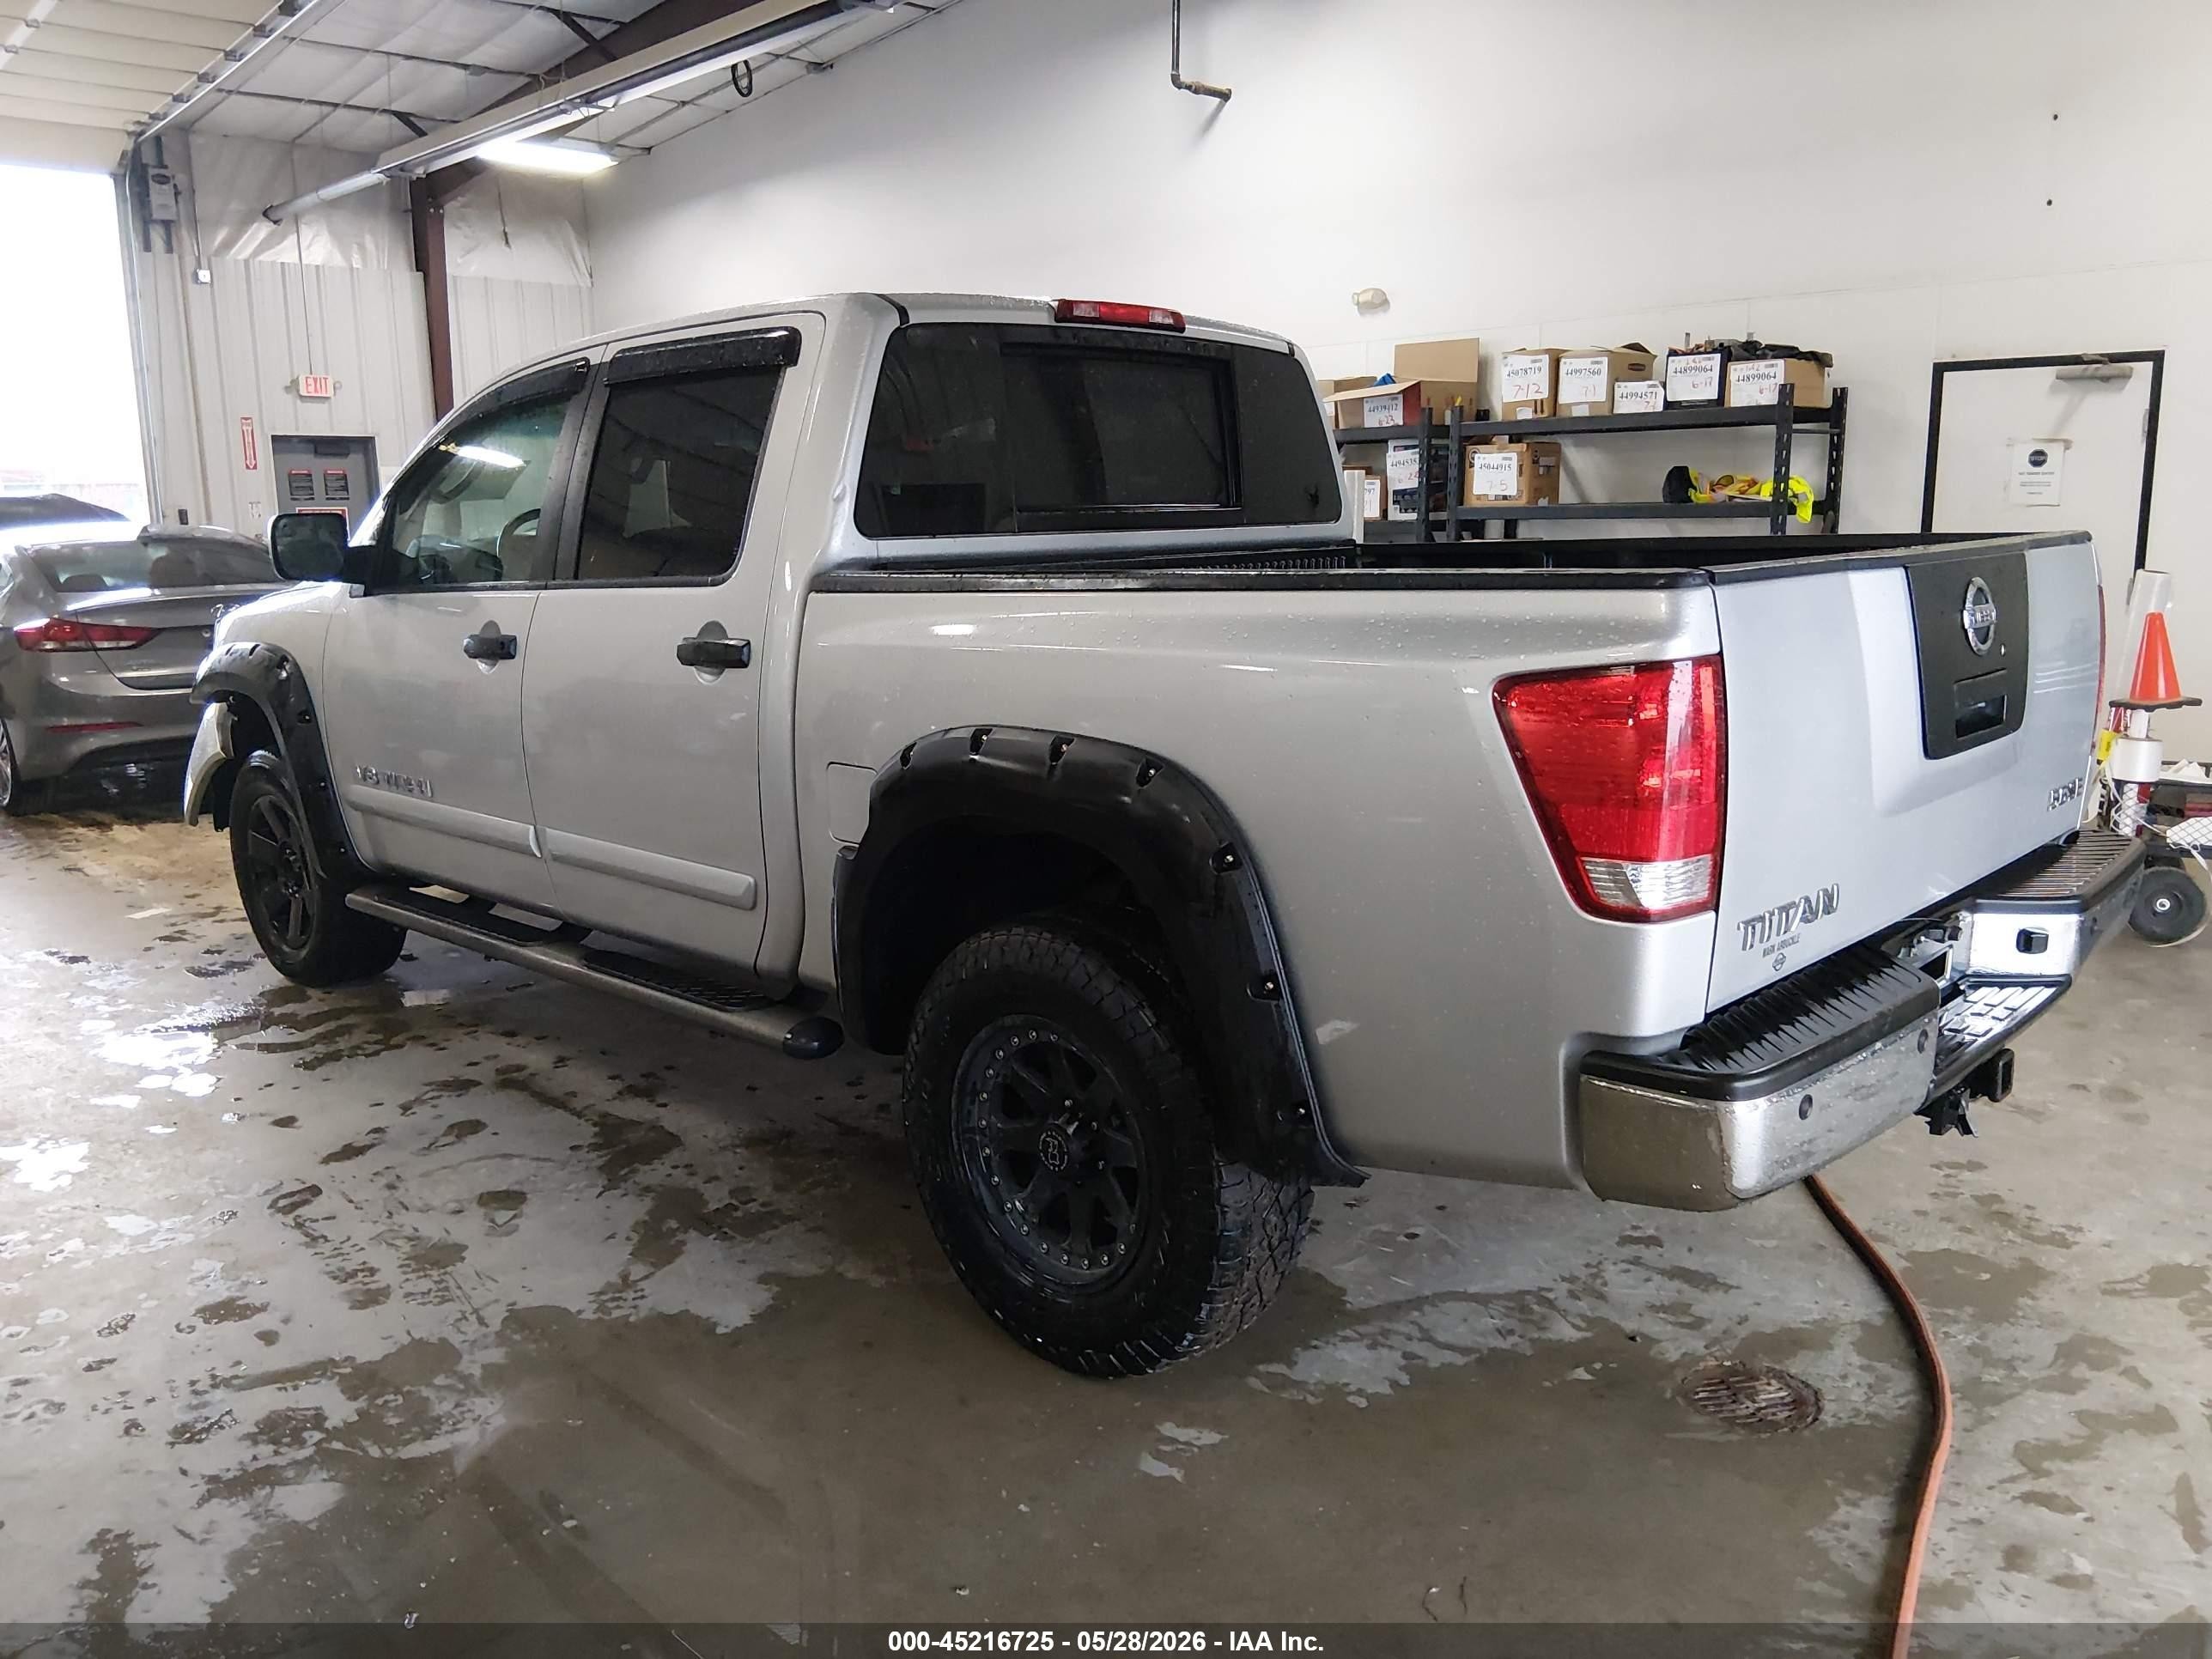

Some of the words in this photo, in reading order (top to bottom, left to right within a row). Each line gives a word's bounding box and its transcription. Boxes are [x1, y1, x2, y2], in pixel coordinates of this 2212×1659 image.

[1507, 366, 1542, 378] 45078719
[1565, 368, 1601, 377] 44997560
[1673, 364, 1713, 375] 44899064
[1735, 371, 1777, 383] 44899064
[305, 376, 329, 395] EXIT
[1479, 463, 1511, 472] 45044915
[1736, 883, 1840, 952] TITAN
